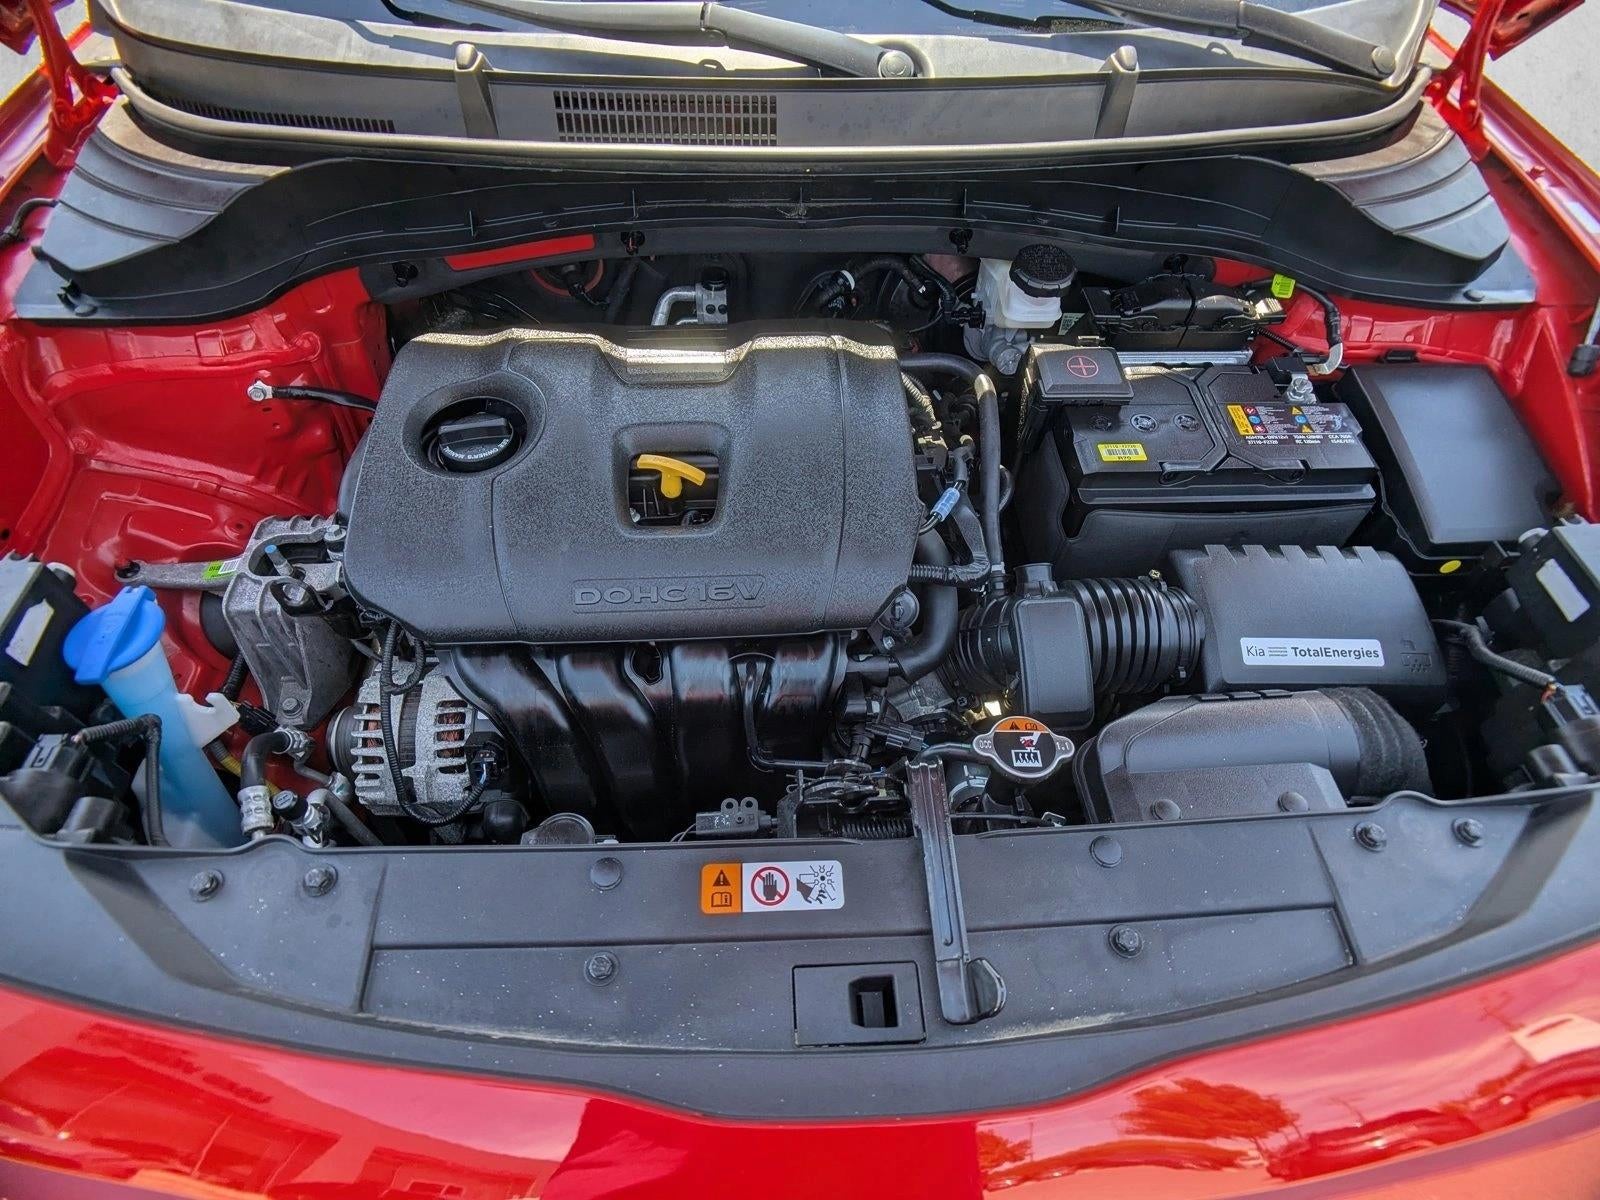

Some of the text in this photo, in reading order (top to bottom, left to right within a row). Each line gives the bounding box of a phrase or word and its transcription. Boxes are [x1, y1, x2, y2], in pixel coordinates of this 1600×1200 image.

[443, 438, 510, 460] SEE OWNER'S MANUAL
[574, 582, 764, 606] DOHC 16V
[1246, 645, 1266, 657] Kia
[1291, 646, 1380, 660] TotalEnergies
